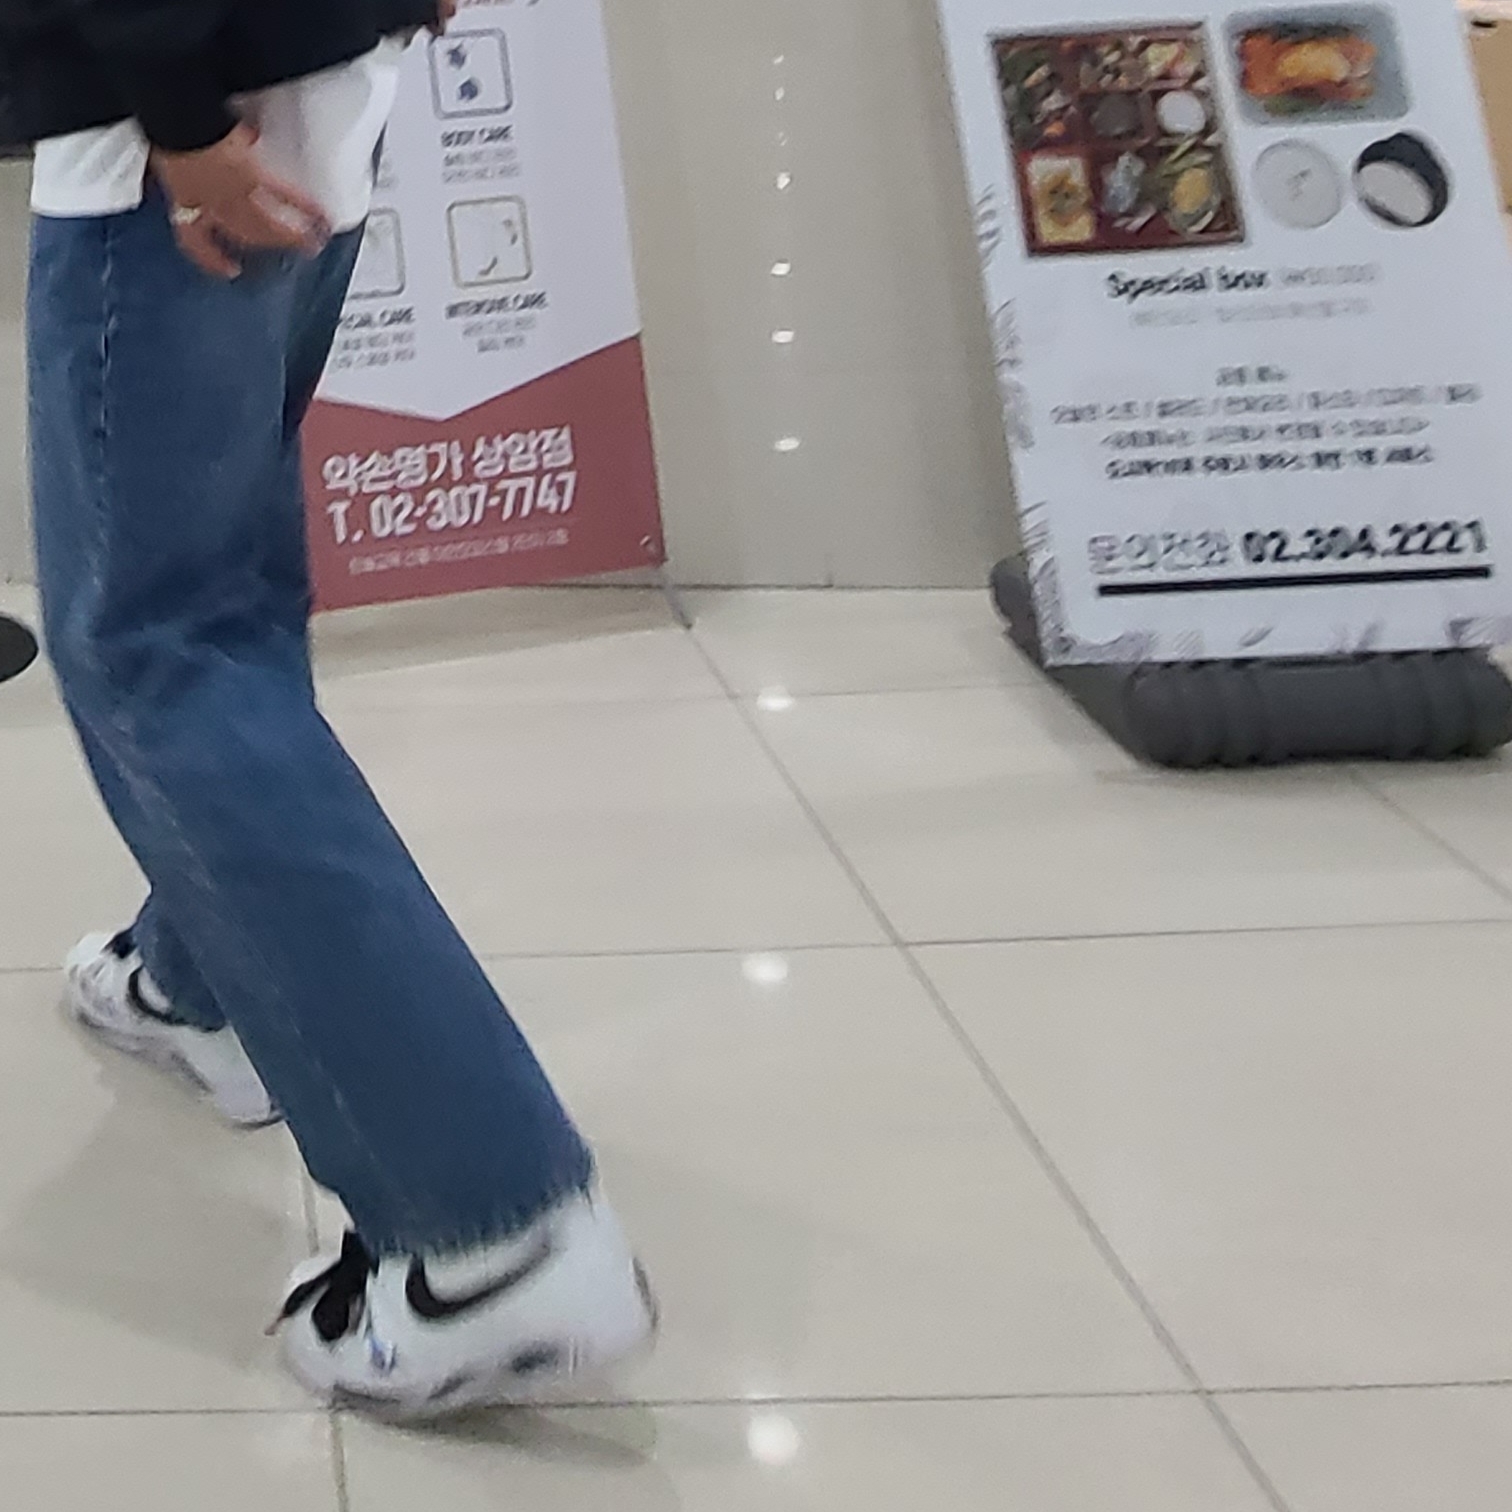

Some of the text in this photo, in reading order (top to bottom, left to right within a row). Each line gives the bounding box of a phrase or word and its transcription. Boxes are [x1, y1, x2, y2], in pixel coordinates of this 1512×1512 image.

[322, 423, 574, 496] 약손명가 상암점
[326, 470, 577, 545] T. 02-307-7747
[1089, 517, 1489, 576] 문의전화 02.304.2221
